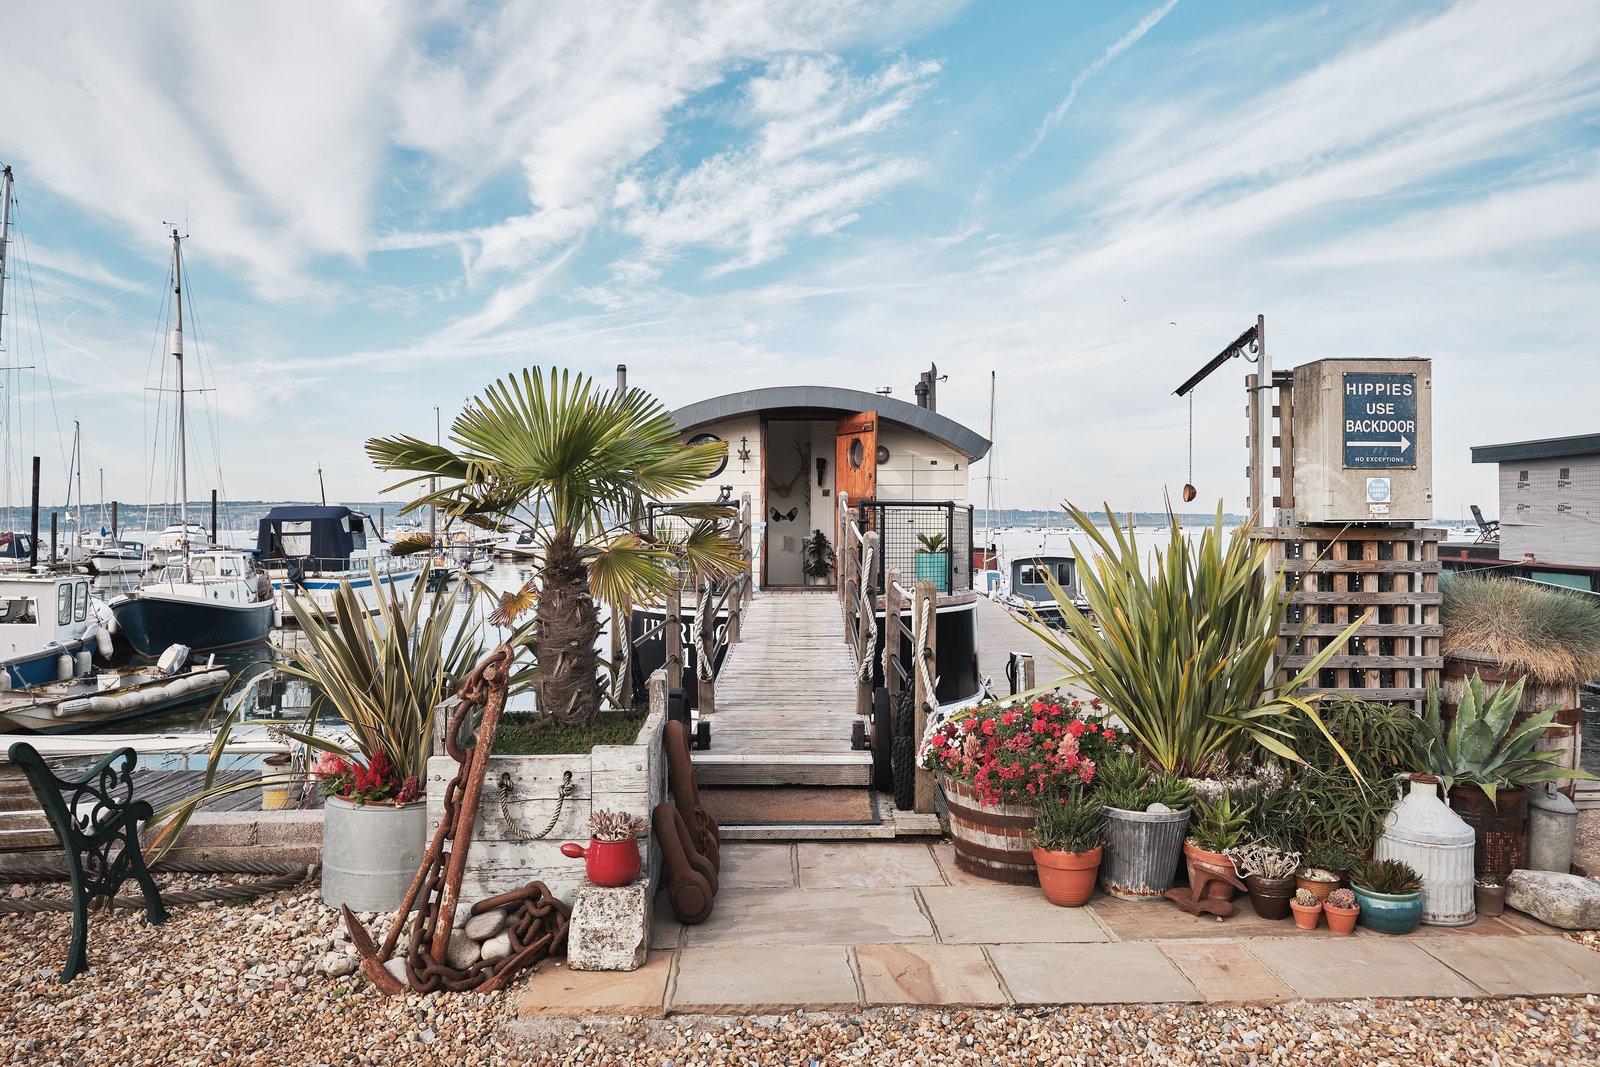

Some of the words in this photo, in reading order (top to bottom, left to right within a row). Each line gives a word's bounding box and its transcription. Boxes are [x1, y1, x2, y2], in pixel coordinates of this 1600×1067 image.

[1346, 383, 1412, 396] HIPPIES
[1366, 402, 1395, 415] USE
[1346, 420, 1415, 433] BACKDOOR
